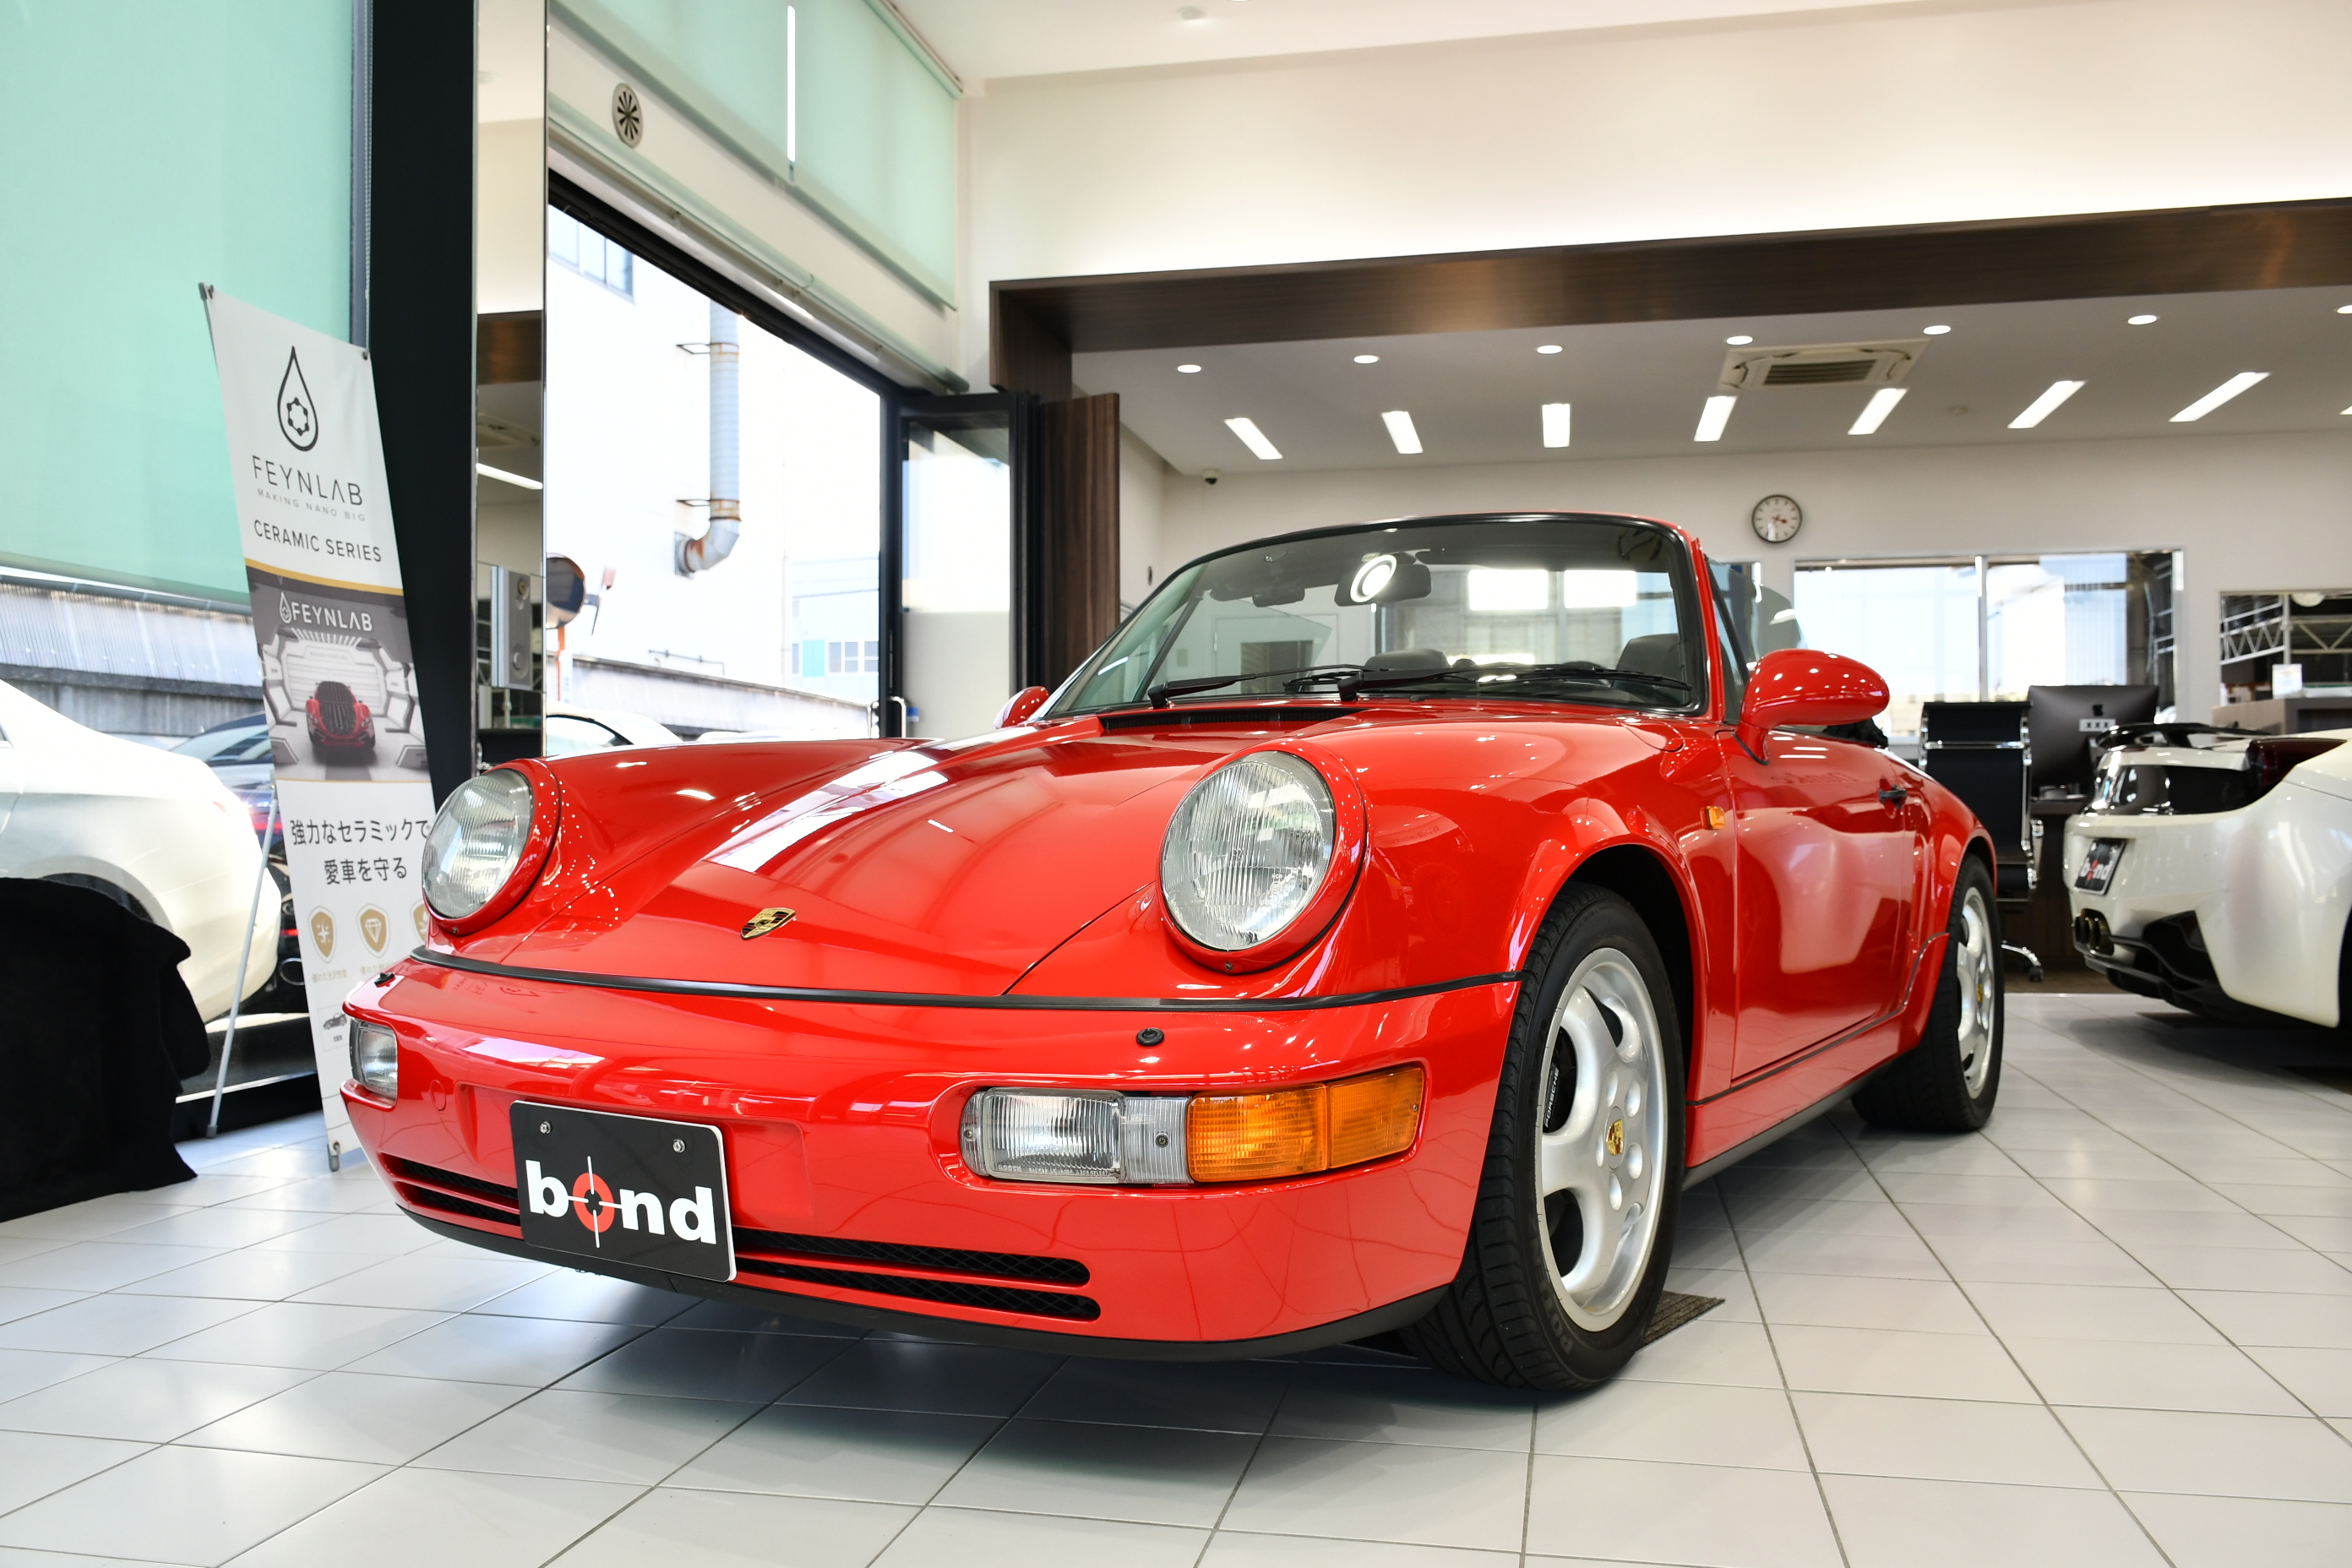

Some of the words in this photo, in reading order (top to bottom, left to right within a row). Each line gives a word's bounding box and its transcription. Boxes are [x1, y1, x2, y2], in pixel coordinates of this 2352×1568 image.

[252, 455, 363, 506] FEYNLAB
[257, 487, 300, 508] MAKING
[306, 503, 338, 517] NANO
[344, 511, 366, 522] BIG
[254, 520, 320, 552] CERAMIC
[325, 538, 382, 563] SERIES
[291, 601, 373, 632] FEYNLAB
[290, 818, 432, 846] 強力なセラミックで
[324, 857, 407, 886] 愛車を守る
[525, 1156, 717, 1248] bond
